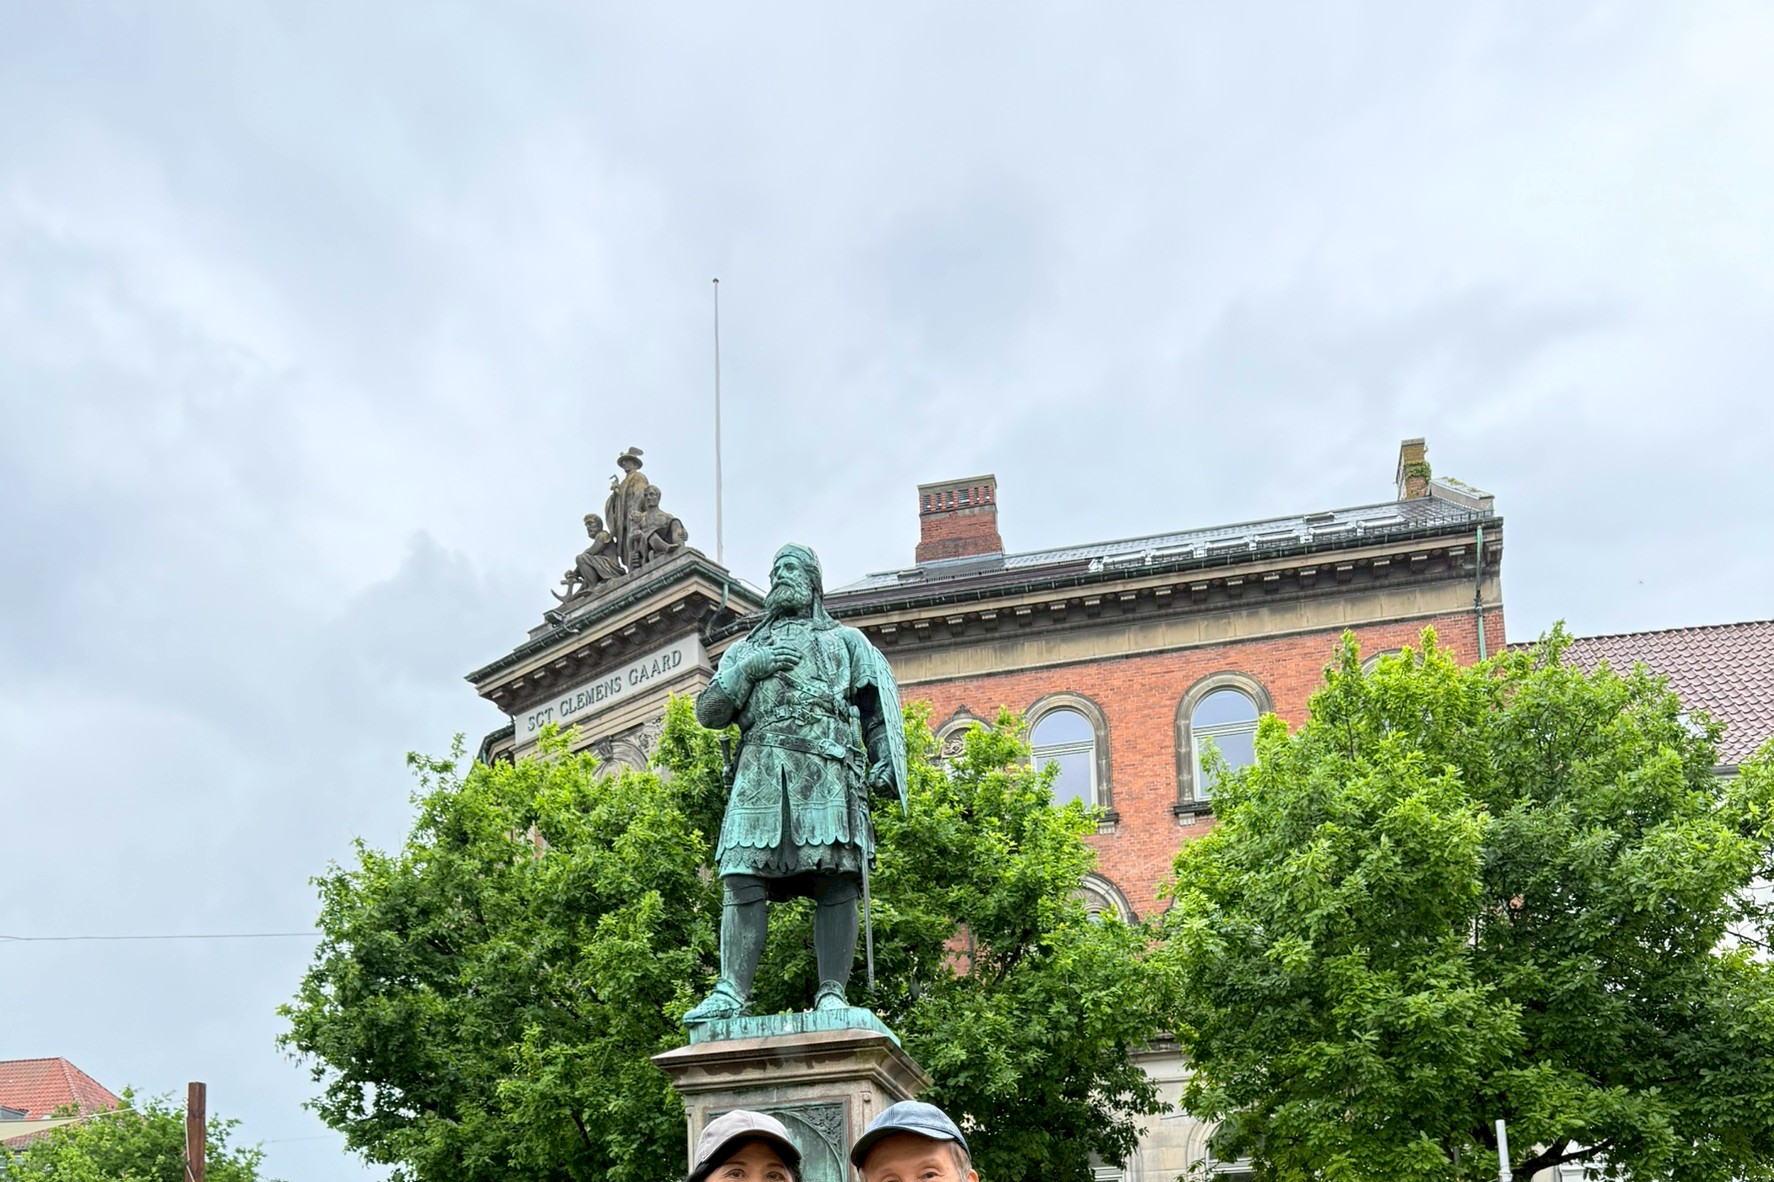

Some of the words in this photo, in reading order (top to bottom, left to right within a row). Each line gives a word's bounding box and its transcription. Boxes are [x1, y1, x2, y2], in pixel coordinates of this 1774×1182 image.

[527, 708, 555, 732] SCT
[560, 676, 622, 717] CLEMENS
[628, 650, 683, 686] GAARD
